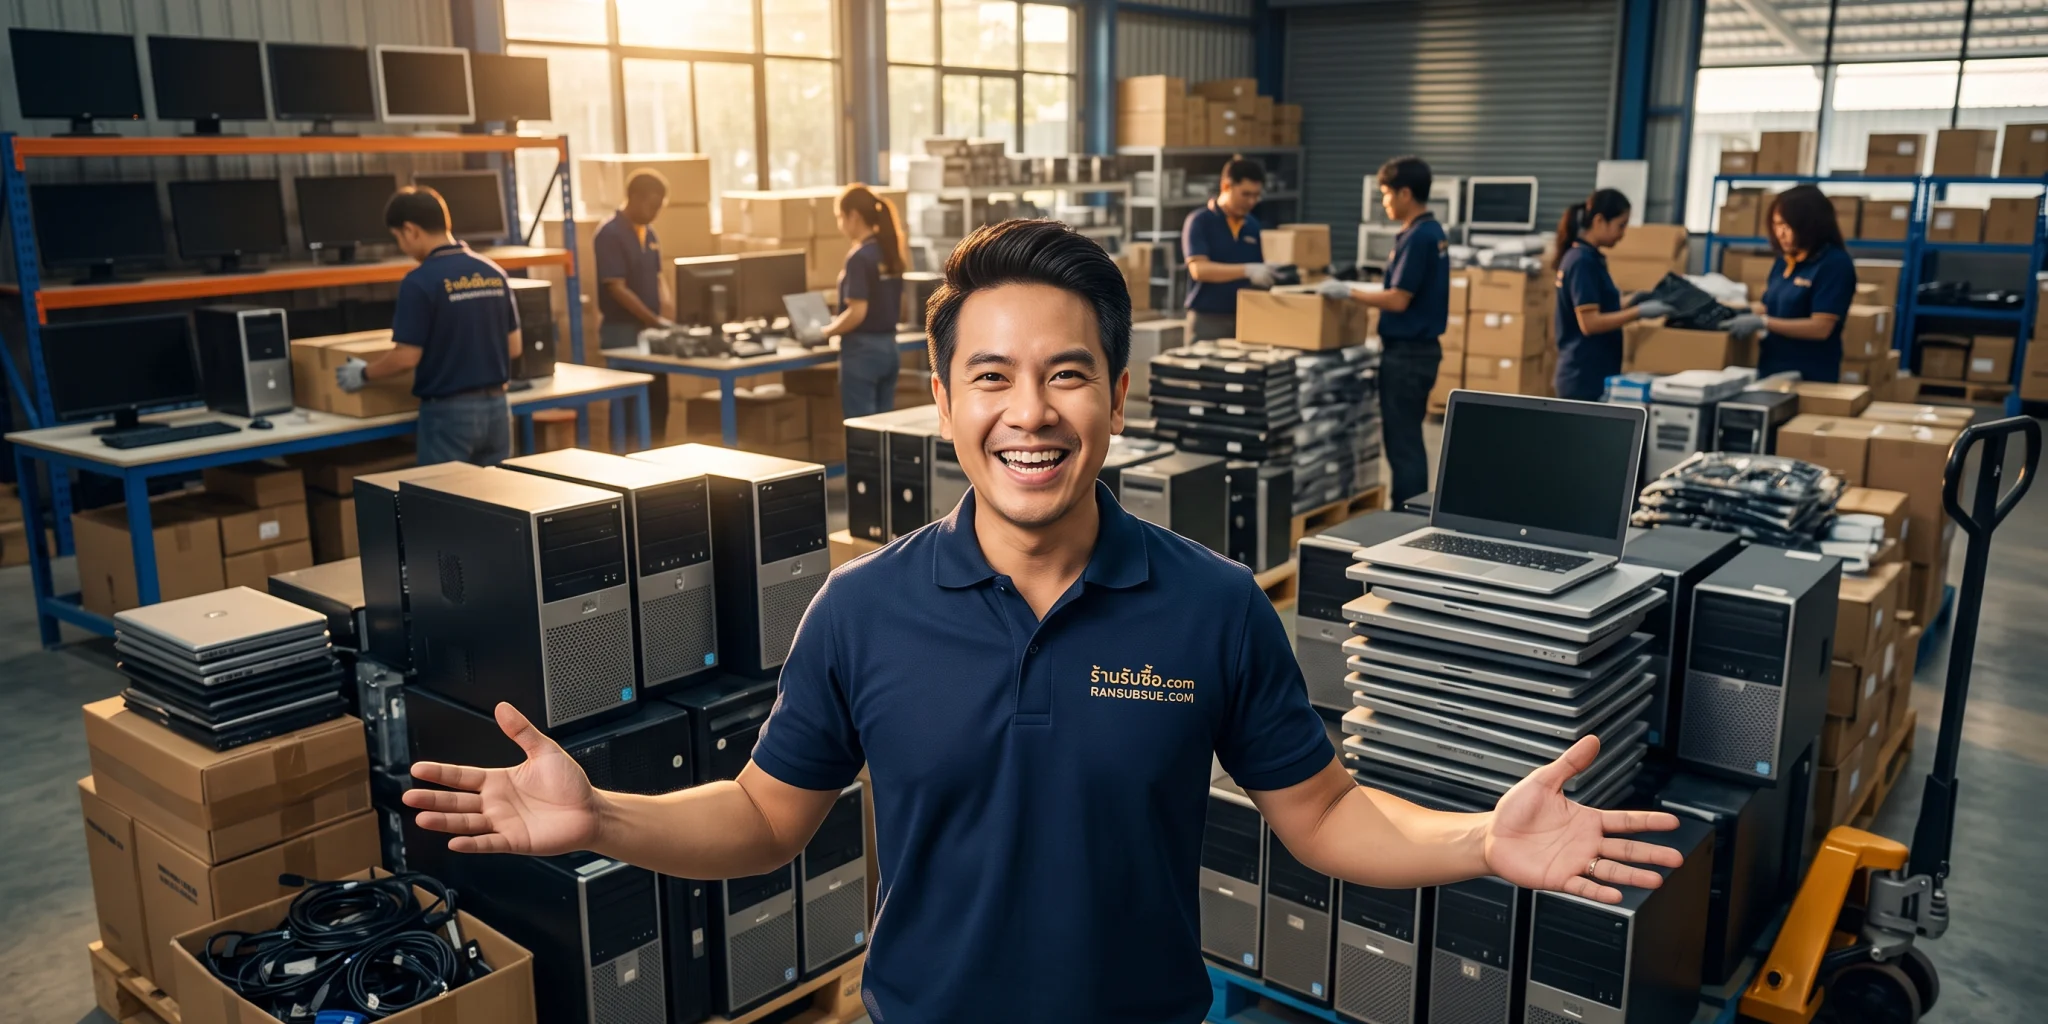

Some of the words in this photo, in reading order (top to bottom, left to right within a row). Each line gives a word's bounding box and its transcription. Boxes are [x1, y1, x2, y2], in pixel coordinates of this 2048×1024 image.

[1090, 664, 1195, 689] ร้านรับซื้อ.com
[1090, 686, 1194, 703] RANSUBSUE.COM
